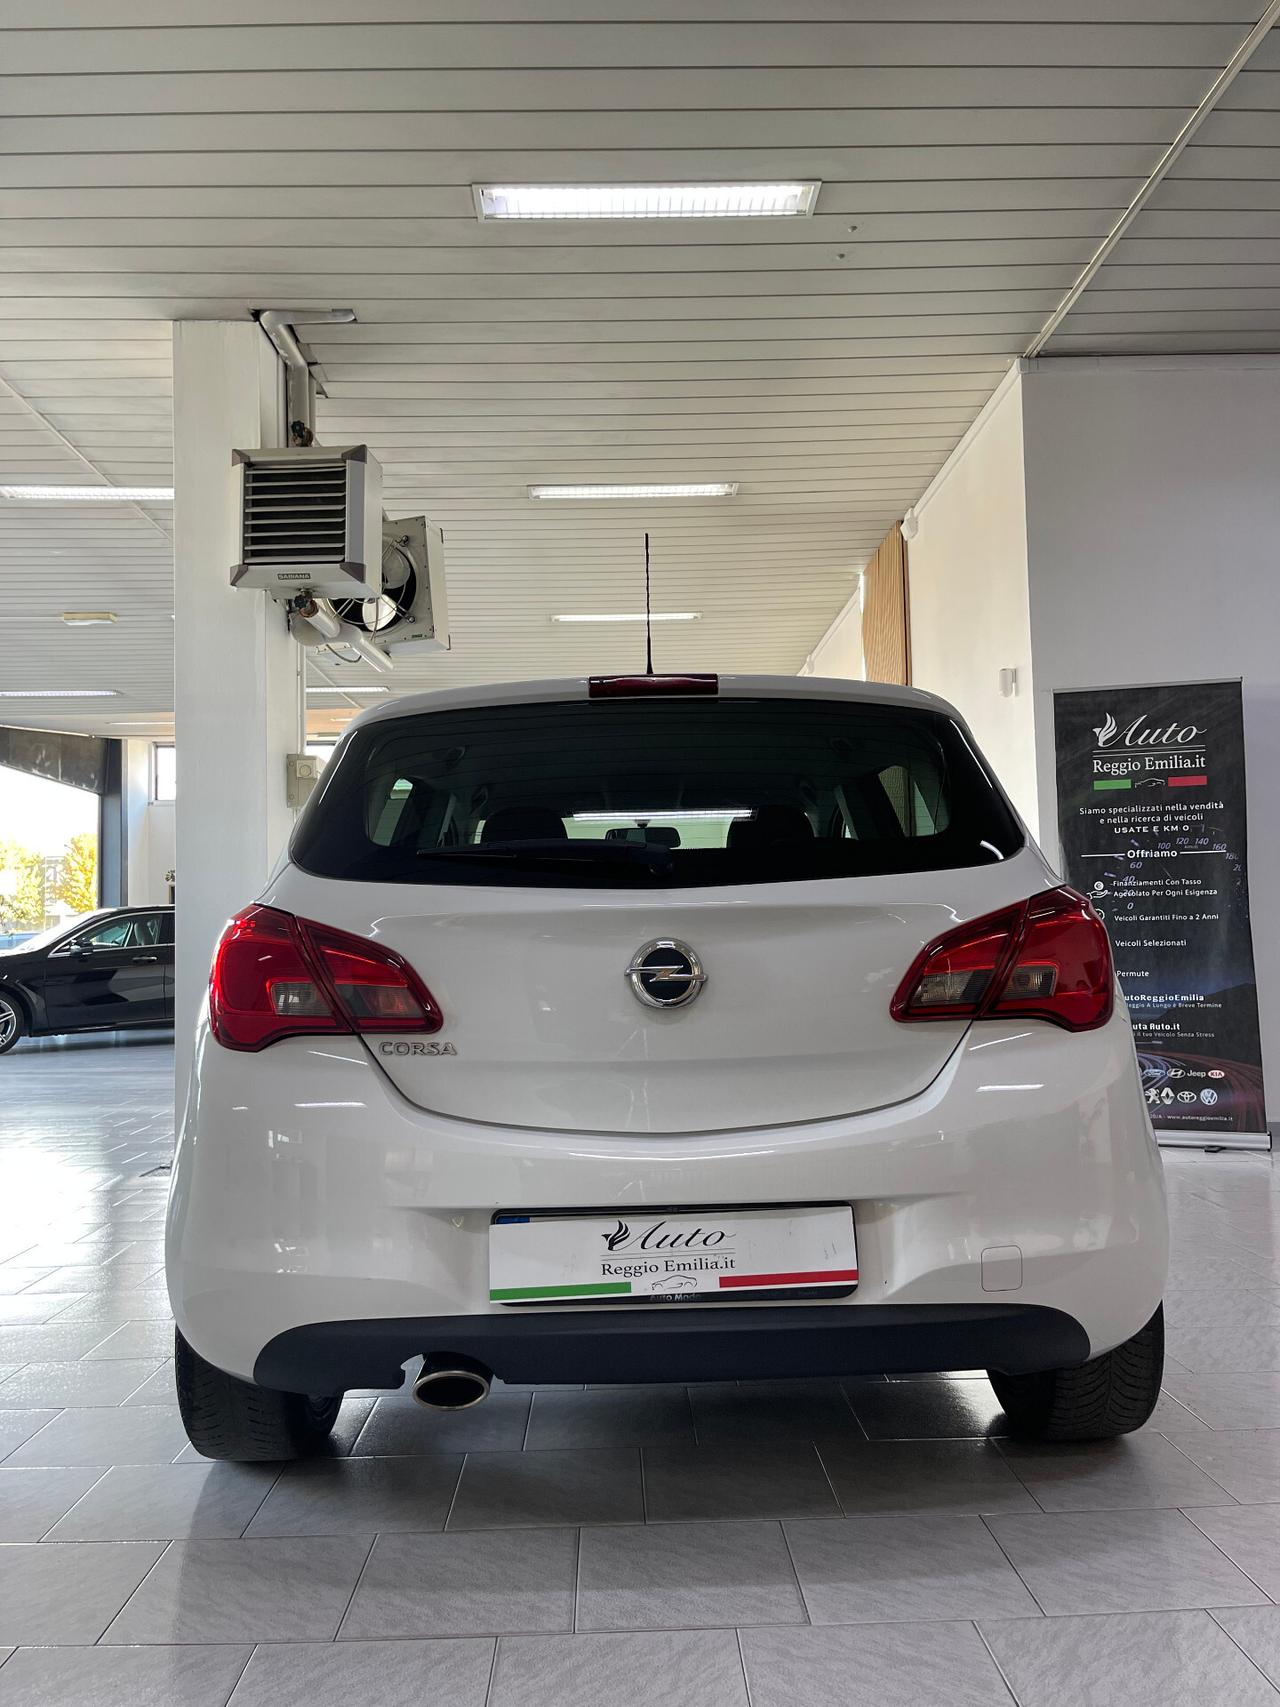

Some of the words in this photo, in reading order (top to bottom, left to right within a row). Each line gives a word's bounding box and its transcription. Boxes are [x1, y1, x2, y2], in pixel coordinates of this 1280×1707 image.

[1110, 714, 1207, 747] Auto
[1093, 758, 1141, 775] Reggio
[1145, 755, 1206, 770] Emilia.it
[1079, 807, 1106, 815] Siamo
[1108, 804, 1163, 815] specializzati
[1165, 803, 1187, 812] nella
[1190, 801, 1224, 810] vendità
[1107, 816, 1128, 824] nella
[1131, 815, 1160, 823] ricerca
[1164, 814, 1172, 822] di
[1174, 813, 1203, 822] veicoli
[1114, 826, 1149, 834] USATE
[1176, 837, 1190, 845] 120
[1195, 837, 1209, 845] 140
[1158, 842, 1171, 850] 100
[1212, 843, 1227, 851] 160
[1127, 850, 1178, 859] Offriamo
[1129, 861, 1142, 869] 60
[1113, 879, 1164, 887] Finanziamenti
[1181, 878, 1202, 886] Tasso
[1165, 889, 1183, 898] Ogni
[1185, 888, 1218, 897] Esigenza
[1143, 939, 1187, 947] Selezionati
[1123, 994, 1205, 1003] utoReggioEmilia
[379, 1042, 457, 1056] CORSA
[1187, 1069, 1206, 1078] Jeep
[617, 1220, 736, 1251] Auto
[601, 1261, 659, 1278] Reggio
[664, 1257, 735, 1272] Emilia.it
